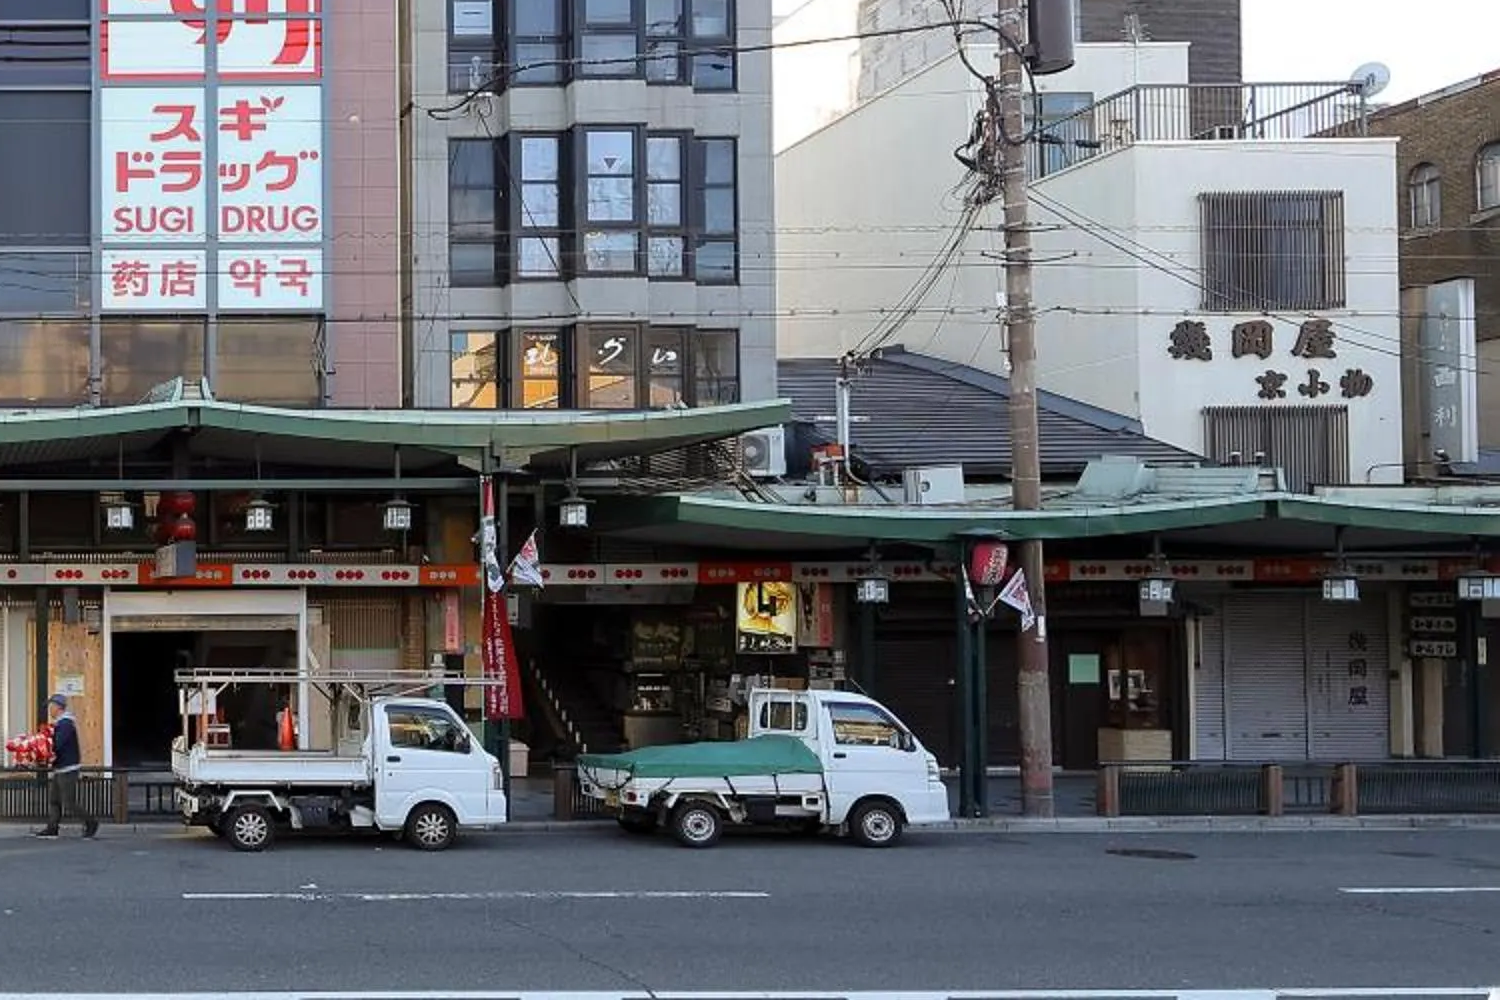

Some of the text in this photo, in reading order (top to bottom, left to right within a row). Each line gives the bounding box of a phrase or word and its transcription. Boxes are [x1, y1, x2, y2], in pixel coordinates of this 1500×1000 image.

[150, 96, 285, 142] スギ
[115, 151, 320, 193] ドラッグ
[114, 205, 319, 233] SUGI DRUG
[111, 261, 197, 297] 药店
[229, 259, 313, 298] 약국
